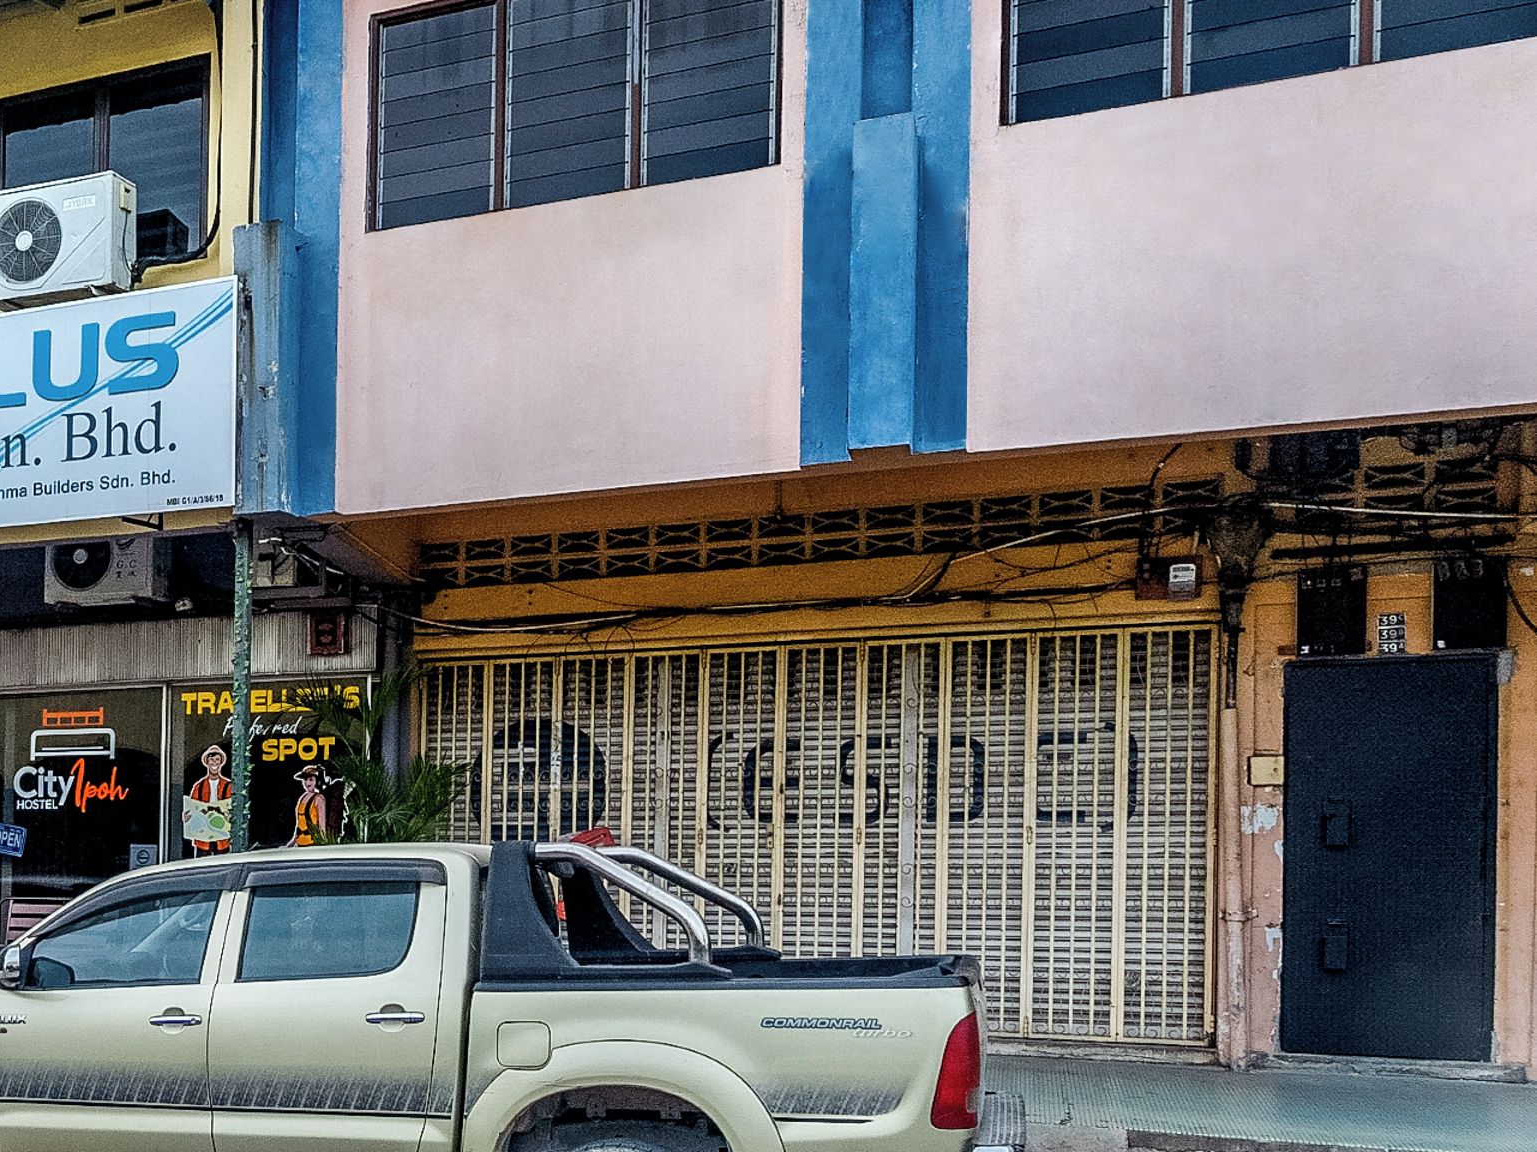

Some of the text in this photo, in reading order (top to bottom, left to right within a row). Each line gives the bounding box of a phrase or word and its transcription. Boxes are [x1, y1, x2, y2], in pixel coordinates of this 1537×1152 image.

[61, 400, 178, 463] Bhd.
[33, 478, 94, 497] Builders
[99, 474, 135, 491] Sdn.
[140, 469, 176, 486] Bhd.
[262, 736, 336, 762] SPOT
[14, 765, 74, 806] City
[16, 799, 60, 810] HOSTEL
[760, 1017, 883, 1031] COMMONRAIL
